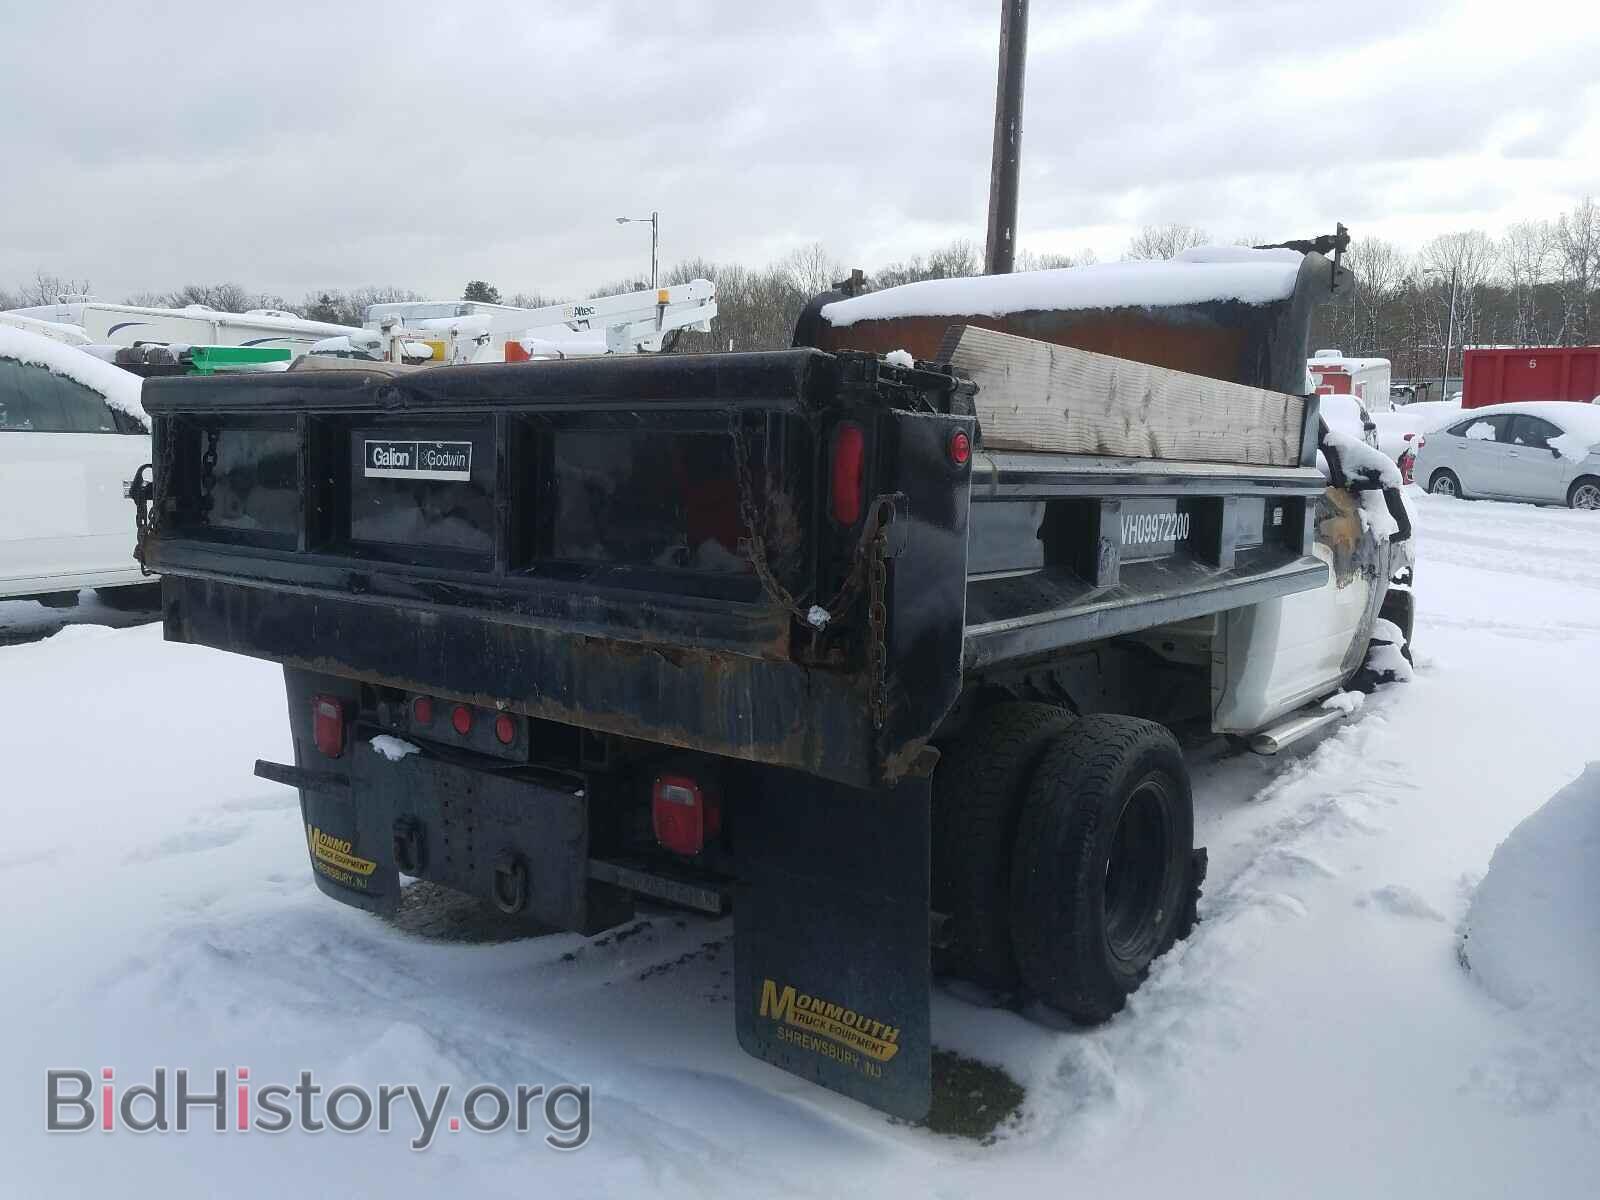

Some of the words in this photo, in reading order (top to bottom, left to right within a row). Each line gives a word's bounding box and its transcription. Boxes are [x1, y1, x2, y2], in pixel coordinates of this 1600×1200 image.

[574, 306, 595, 317] Altec
[373, 447, 410, 466] Galion
[427, 449, 466, 467] Godwin
[1121, 512, 1190, 545] VH09972200
[759, 979, 900, 1043] MONMOUTH
[794, 1010, 827, 1029] TRUCK
[829, 1024, 886, 1056] EQUIPMENT
